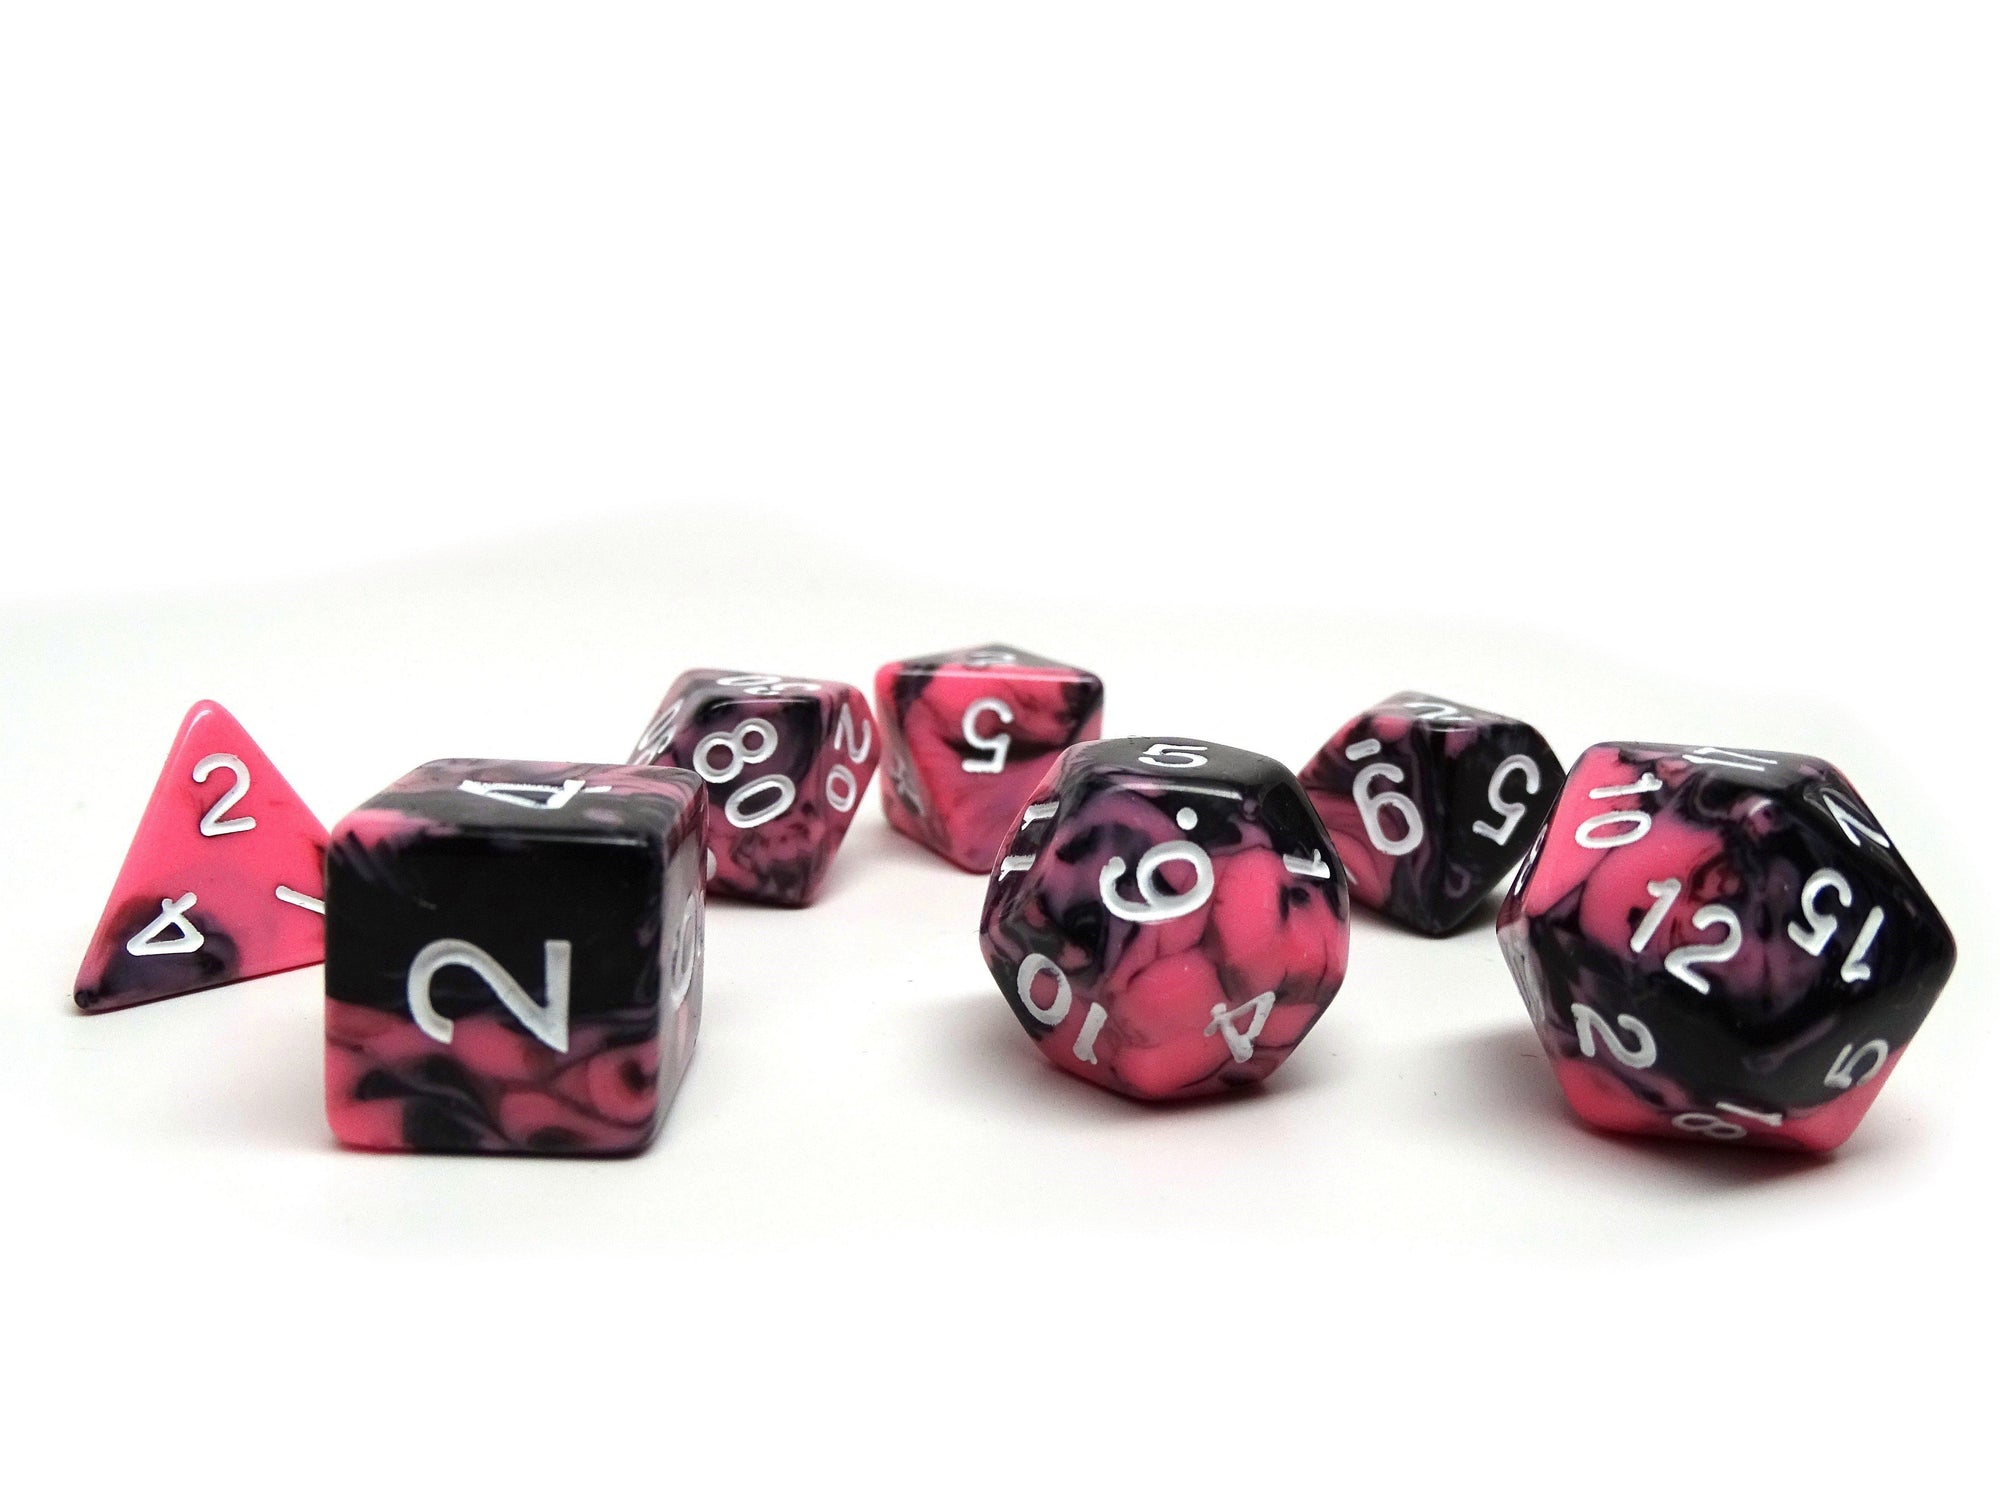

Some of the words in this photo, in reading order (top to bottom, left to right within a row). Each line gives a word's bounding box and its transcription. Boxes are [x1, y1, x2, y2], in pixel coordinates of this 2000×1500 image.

[962, 697, 1014, 773] 5
[1402, 702, 1473, 721] 2
[693, 718, 796, 829] 80
[825, 703, 872, 813] 20
[1138, 743, 1208, 768] 5
[192, 753, 256, 837] 2
[457, 779, 612, 809] 4
[1472, 754, 1541, 846] 5
[1575, 772, 1663, 849] 10
[998, 800, 1059, 881] 11
[1283, 848, 1331, 879] 1
[127, 892, 204, 956] 4
[1631, 877, 1743, 994] 12
[1787, 867, 1884, 983] 15
[407, 938, 571, 1053] 2
[1016, 953, 1108, 1065] 10
[1204, 991, 1276, 1063] 4
[1571, 1003, 1657, 1069] 2
[1824, 1038, 1889, 1089] 5
[1671, 1101, 1783, 1140] 18
